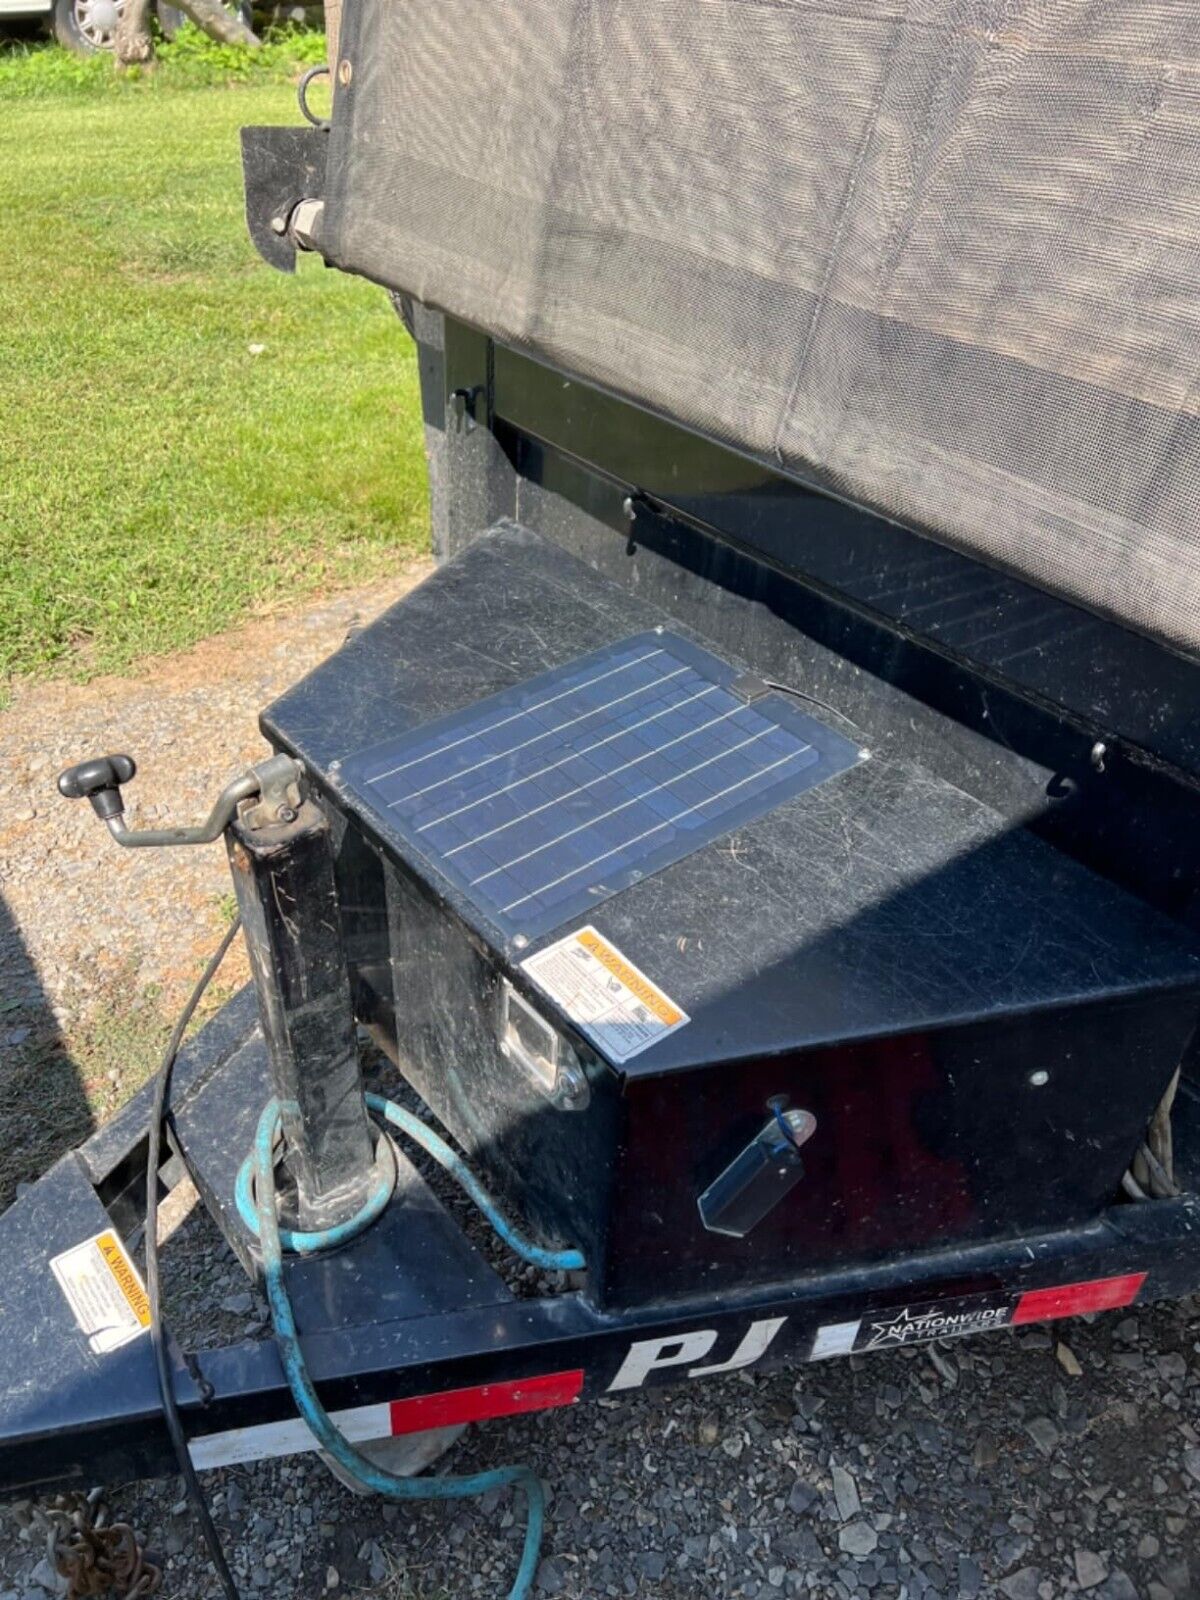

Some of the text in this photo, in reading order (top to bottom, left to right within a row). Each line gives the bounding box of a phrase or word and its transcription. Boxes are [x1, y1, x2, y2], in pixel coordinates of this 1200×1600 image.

[600, 947, 670, 1016] WARNING
[110, 1255, 151, 1317] WARNING
[887, 1306, 1009, 1334] NATIONWIDE
[606, 1316, 788, 1393] PJ
